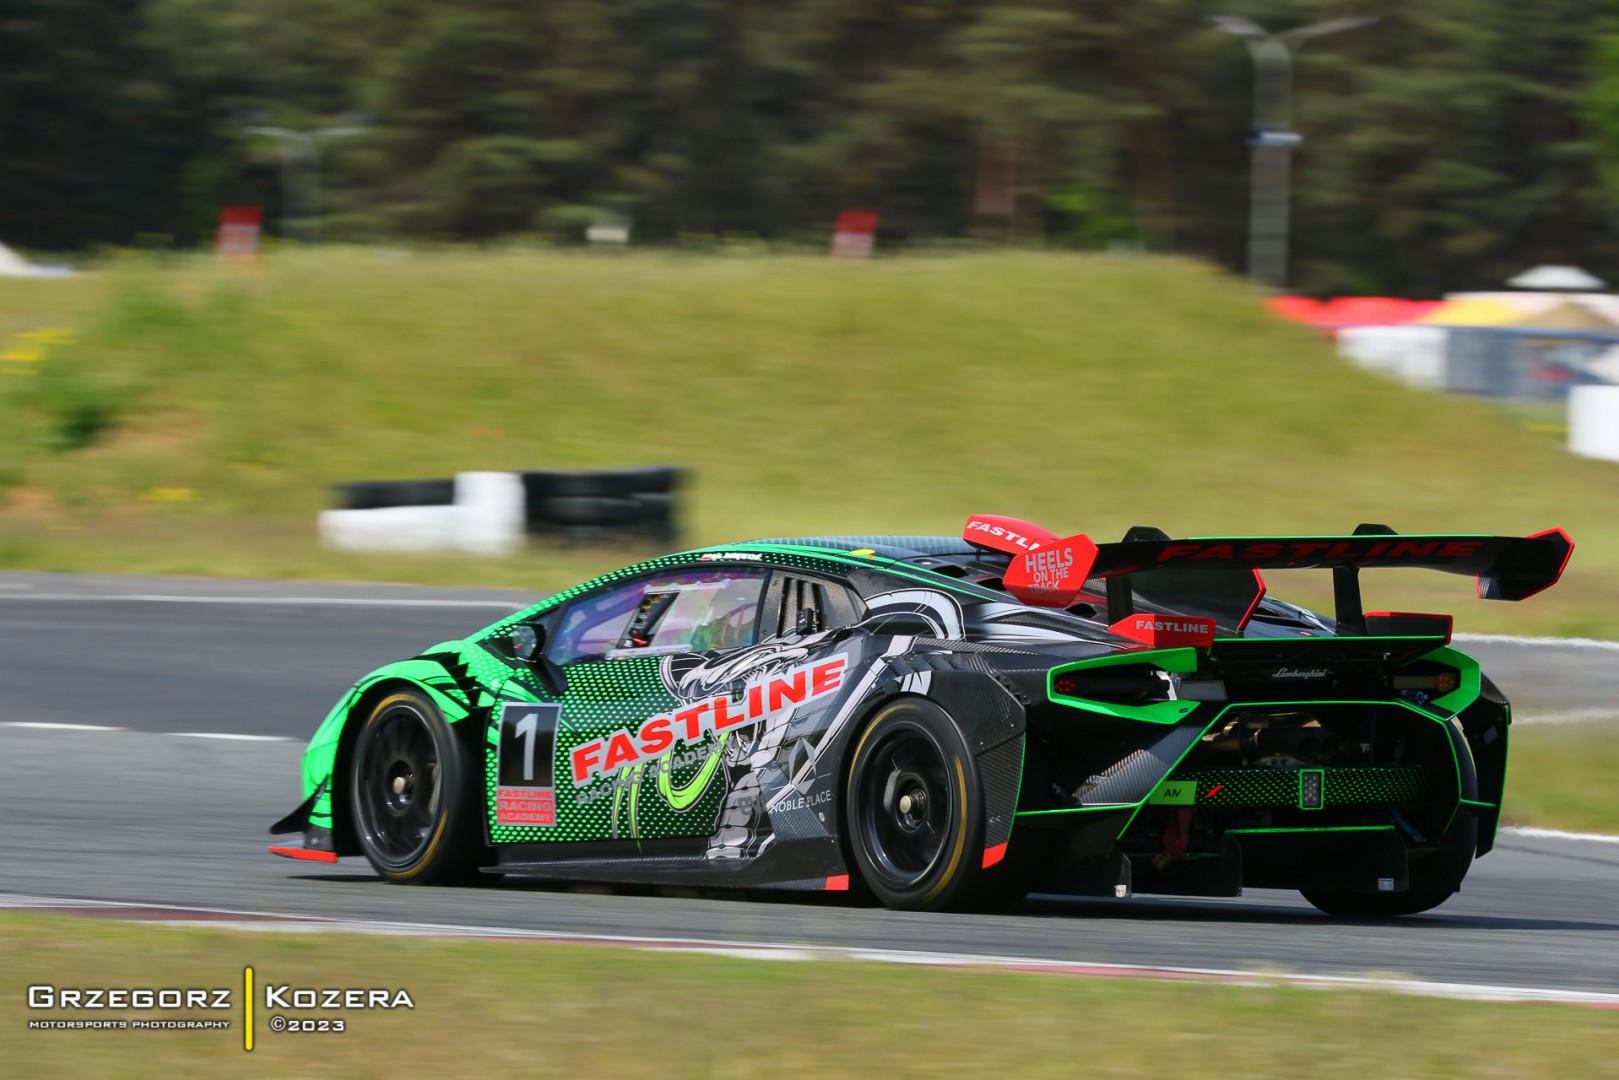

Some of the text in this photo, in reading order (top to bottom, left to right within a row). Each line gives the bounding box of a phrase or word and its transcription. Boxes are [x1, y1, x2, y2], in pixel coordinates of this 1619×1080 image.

[1155, 541, 1484, 561] FASTLINE
[1025, 547, 1073, 573] HEELS
[1033, 567, 1069, 583] ON THE
[1027, 580, 1060, 594] TRACK
[1135, 620, 1209, 634] FASTLINE
[1271, 667, 1328, 680] Lamborghini
[571, 658, 845, 783] FASTLINE
[514, 713, 539, 781] 1
[497, 789, 553, 798] FASTLINE
[499, 800, 551, 812] RACING
[768, 798, 805, 815] NOBLE
[806, 790, 832, 808] PLACE
[500, 812, 552, 822] ACADEMY
